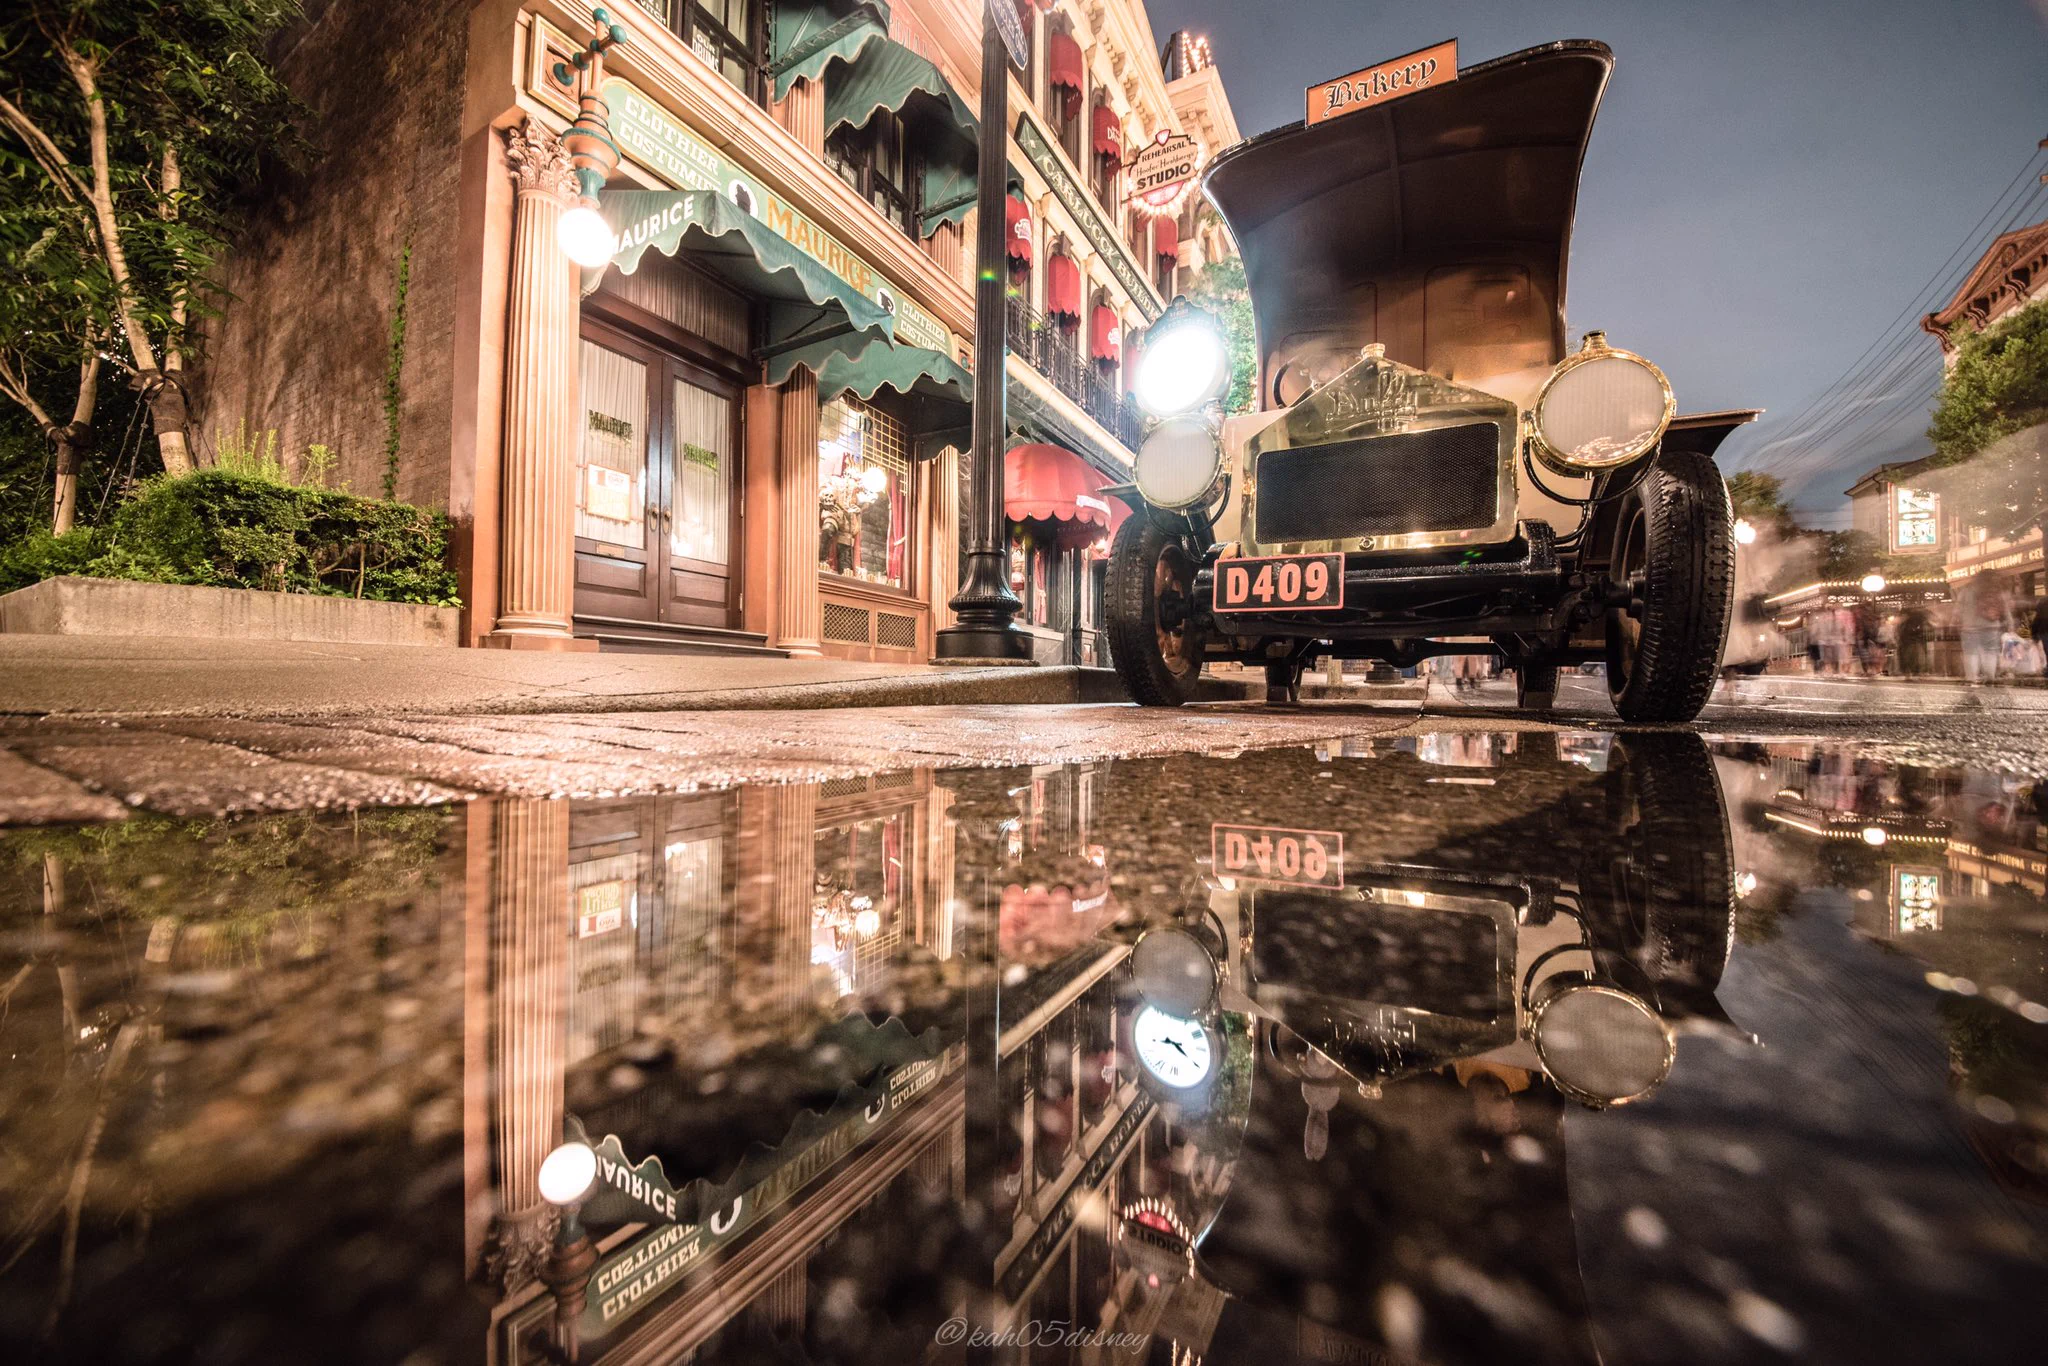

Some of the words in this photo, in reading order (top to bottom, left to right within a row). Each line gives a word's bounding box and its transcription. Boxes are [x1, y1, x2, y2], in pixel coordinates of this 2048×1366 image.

[1322, 57, 1437, 117] Bakery
[624, 94, 719, 176] CLOTHIER
[1141, 141, 1186, 162] REHEARSAL
[1136, 162, 1191, 190] STUDIO
[767, 196, 874, 299] MAURICE
[902, 301, 946, 343] CLOTHIER
[1225, 560, 1329, 604] D409
